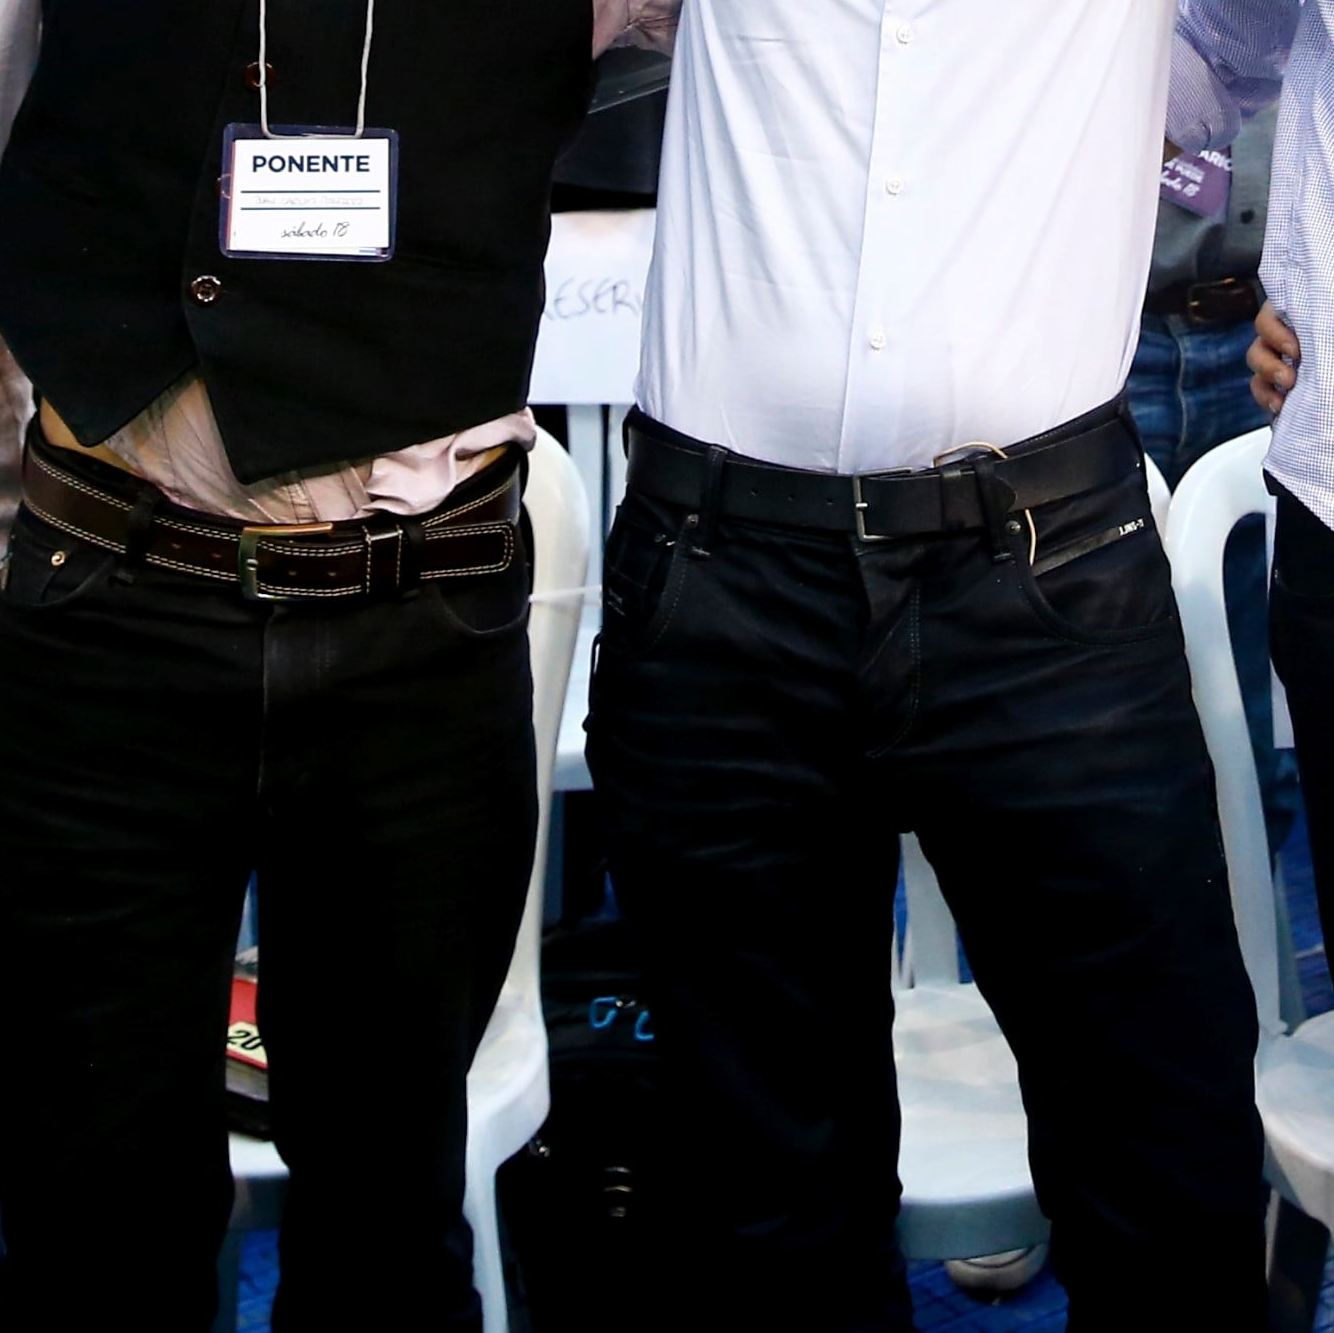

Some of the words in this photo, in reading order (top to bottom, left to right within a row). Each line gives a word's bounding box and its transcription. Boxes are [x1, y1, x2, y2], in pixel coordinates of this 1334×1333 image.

[252, 155, 371, 173] PONENTE
[280, 220, 329, 239] sábado
[332, 221, 351, 238] 18
[543, 276, 644, 322] ESER
